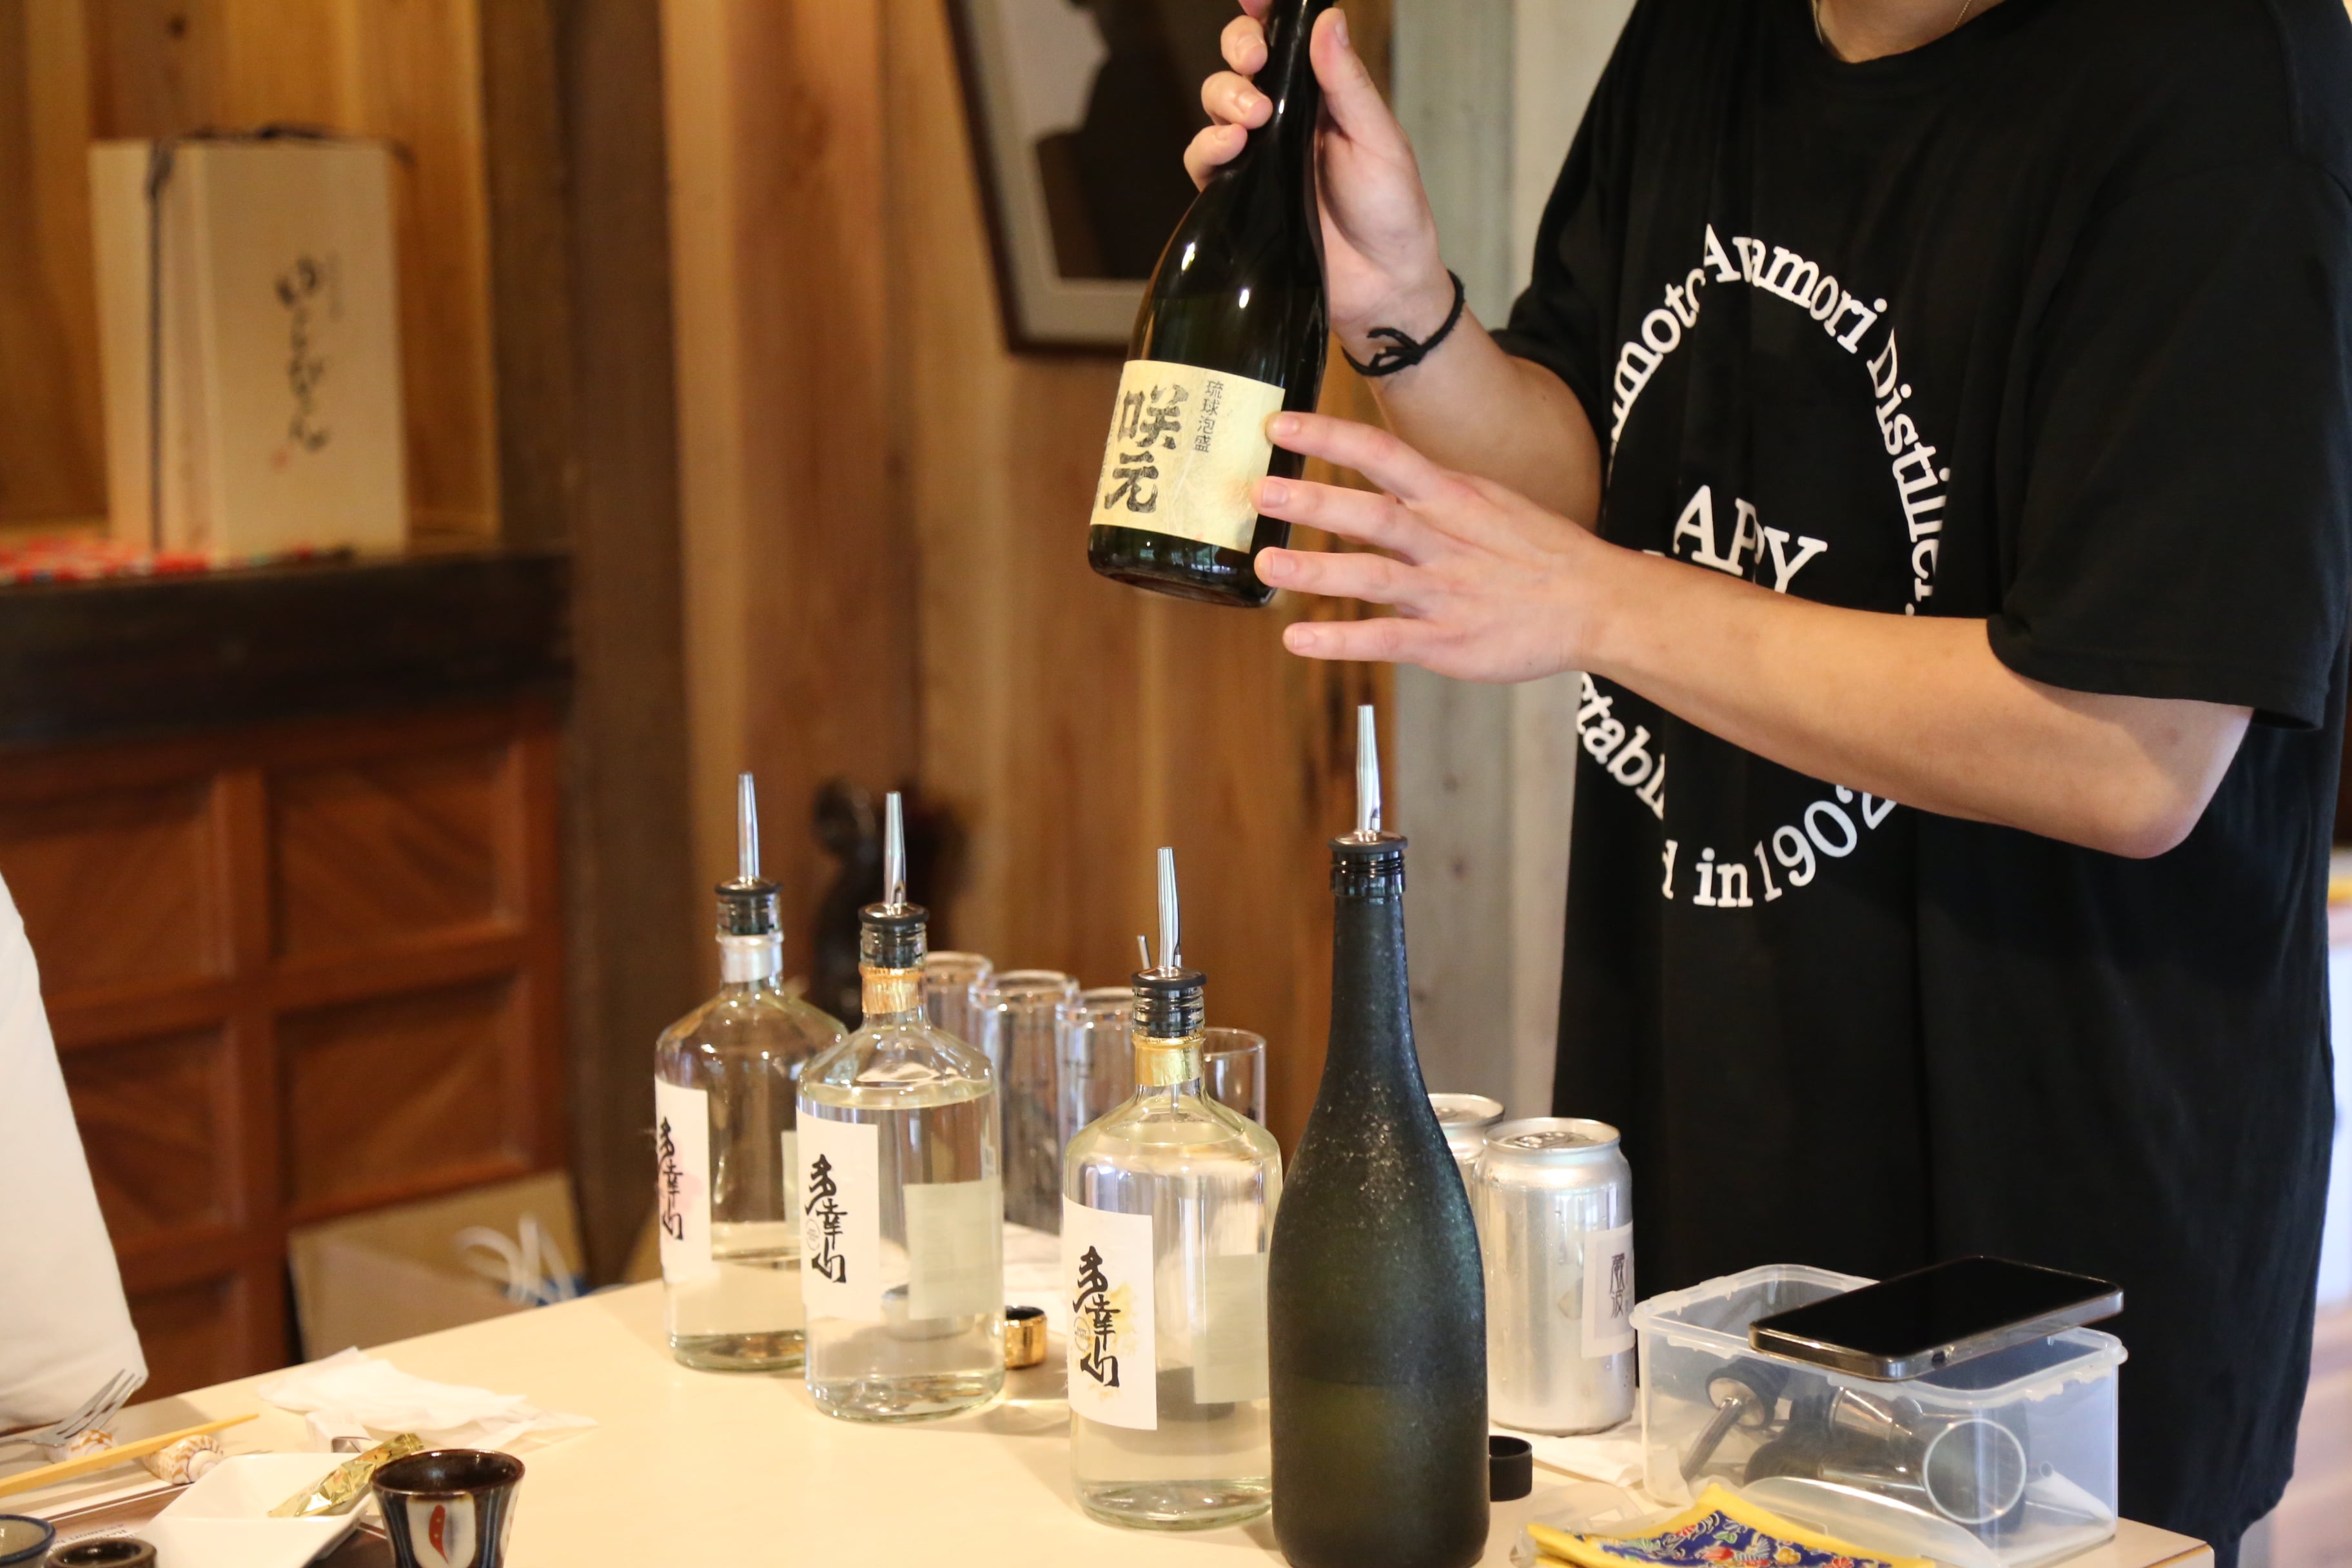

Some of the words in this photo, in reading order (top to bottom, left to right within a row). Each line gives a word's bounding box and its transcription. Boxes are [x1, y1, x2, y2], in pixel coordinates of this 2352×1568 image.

[1104, 384, 1190, 513] 咲元
[1193, 380, 1224, 453] 琉球泡盛
[1693, 847, 1754, 908] in
